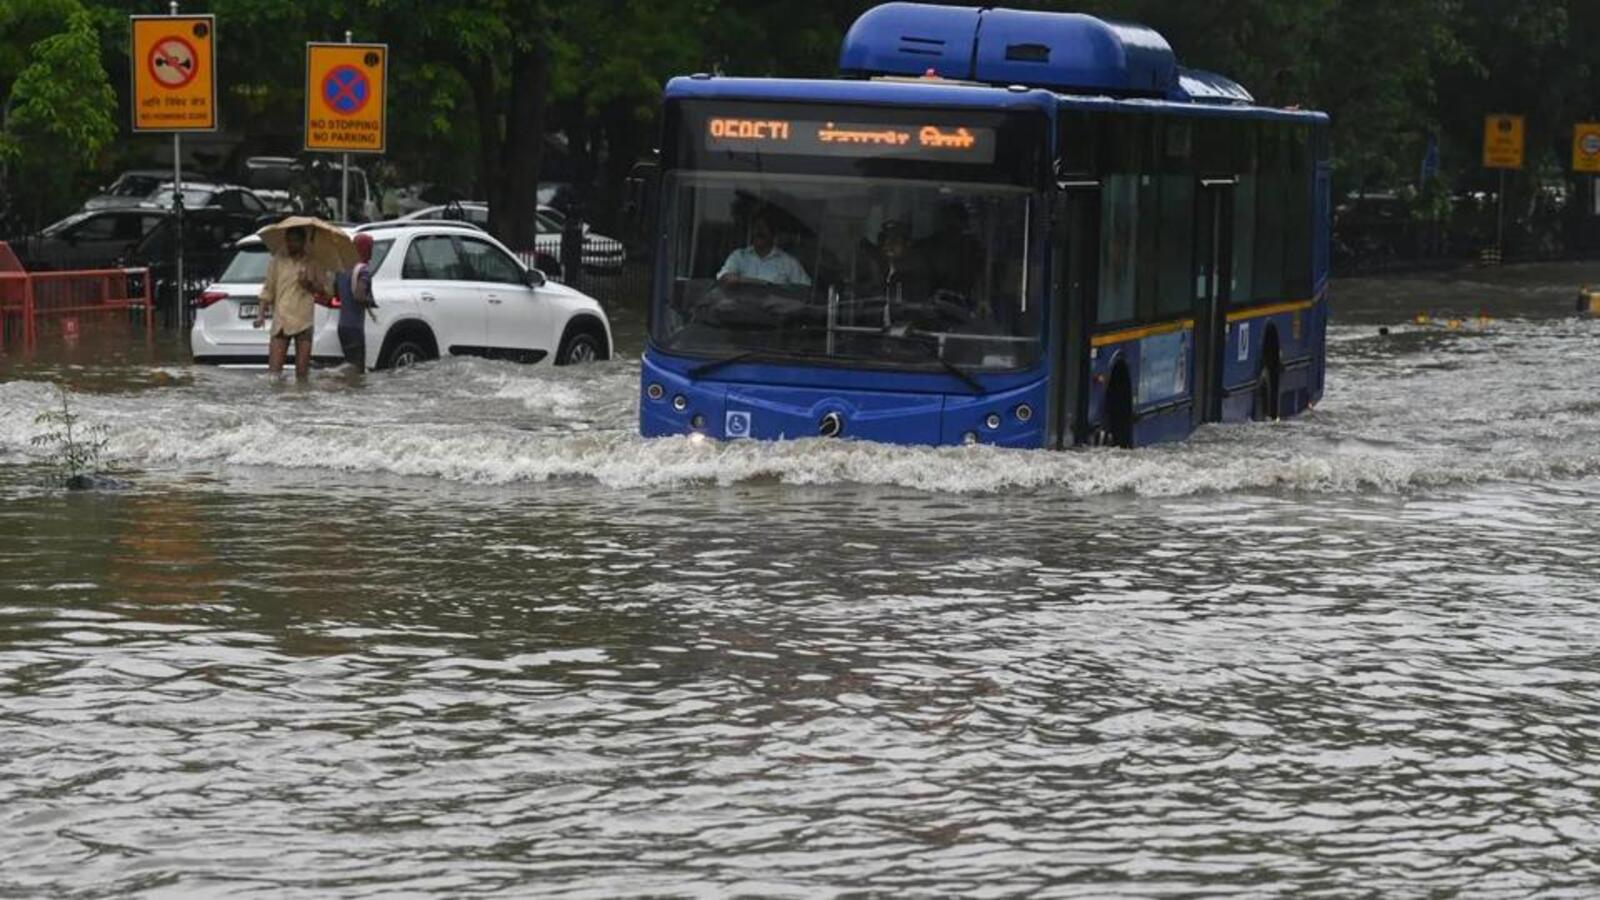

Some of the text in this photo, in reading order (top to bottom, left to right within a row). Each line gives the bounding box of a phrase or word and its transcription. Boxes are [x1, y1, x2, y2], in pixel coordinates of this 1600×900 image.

[311, 119, 379, 131] NO STOPPING
[313, 132, 376, 144] NO PARKING
